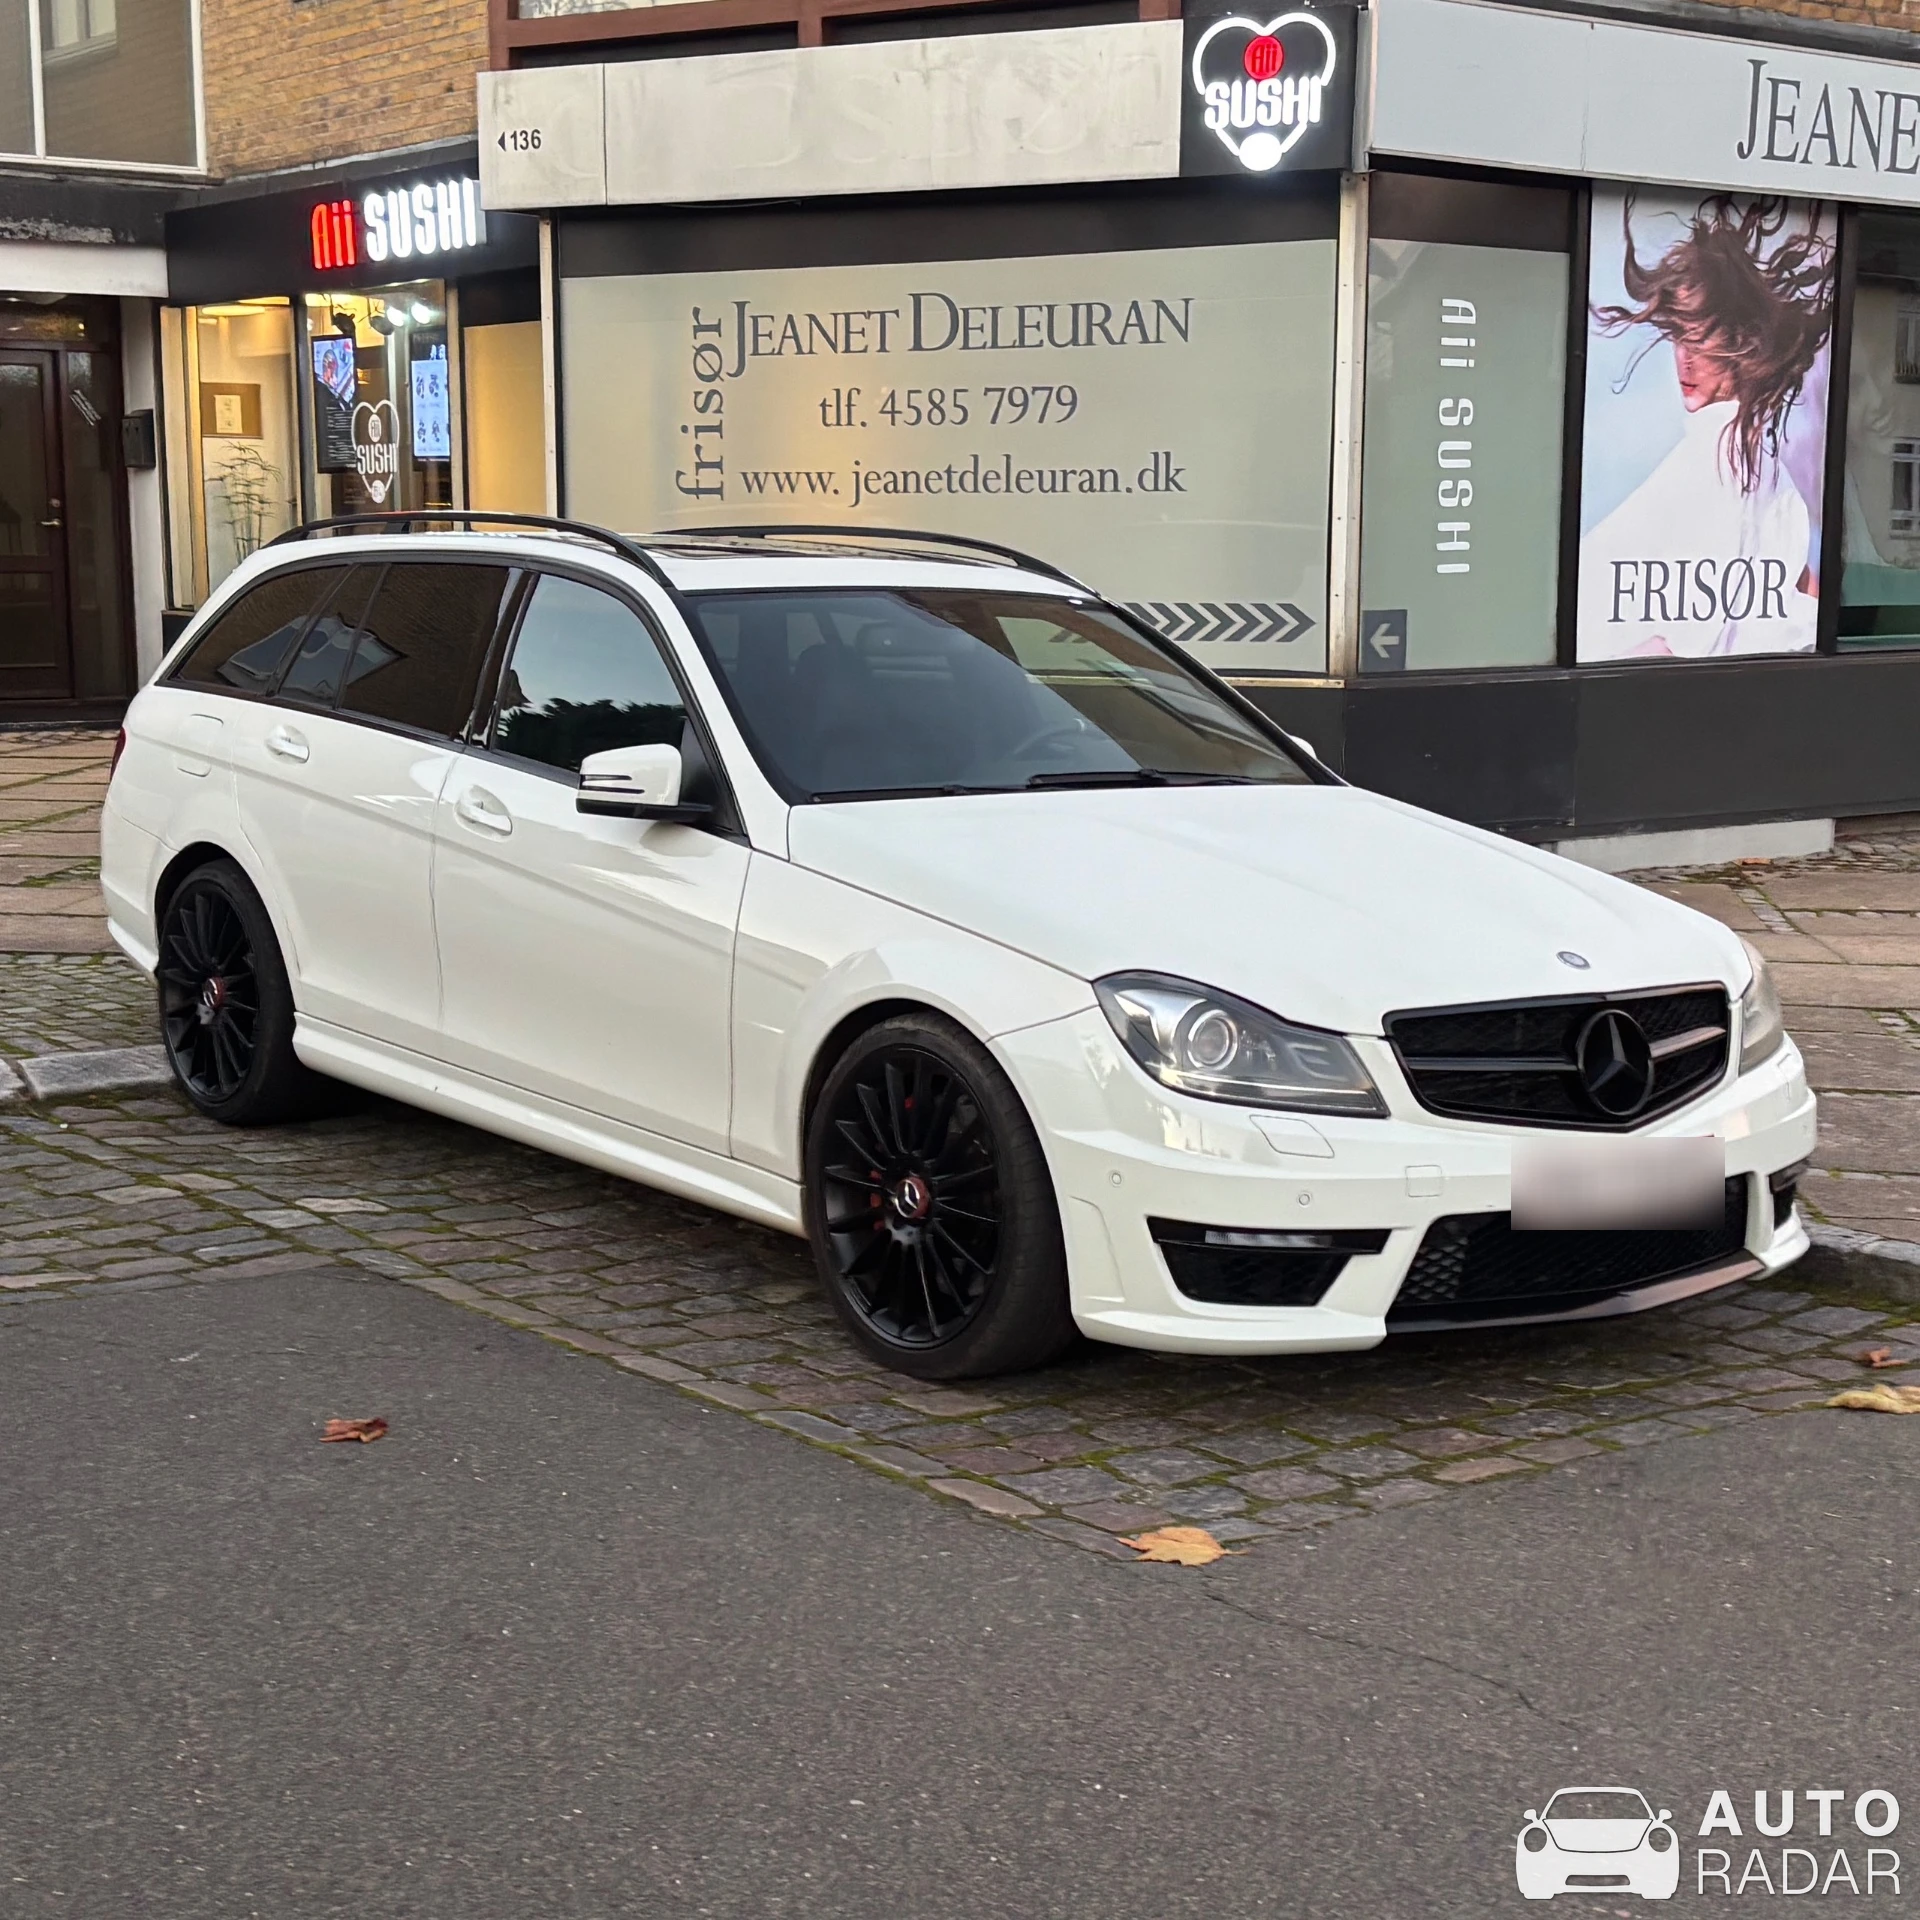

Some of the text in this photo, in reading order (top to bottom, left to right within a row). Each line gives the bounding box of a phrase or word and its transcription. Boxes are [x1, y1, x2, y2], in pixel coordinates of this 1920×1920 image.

[1251, 44, 1277, 74] Aii
[1204, 75, 1321, 130] SUSHI
[1736, 58, 1920, 175] JEANE
[510, 128, 542, 150] 136
[363, 177, 477, 262] SUSHI
[725, 292, 1195, 378] JEANET DELEURAN
[676, 306, 724, 501] frisør
[820, 384, 1079, 428] tlf. 4585 7979
[1436, 298, 1476, 573] Aii SUSHI
[357, 443, 397, 474] SUSHI
[1608, 556, 1788, 625] FRISØR
